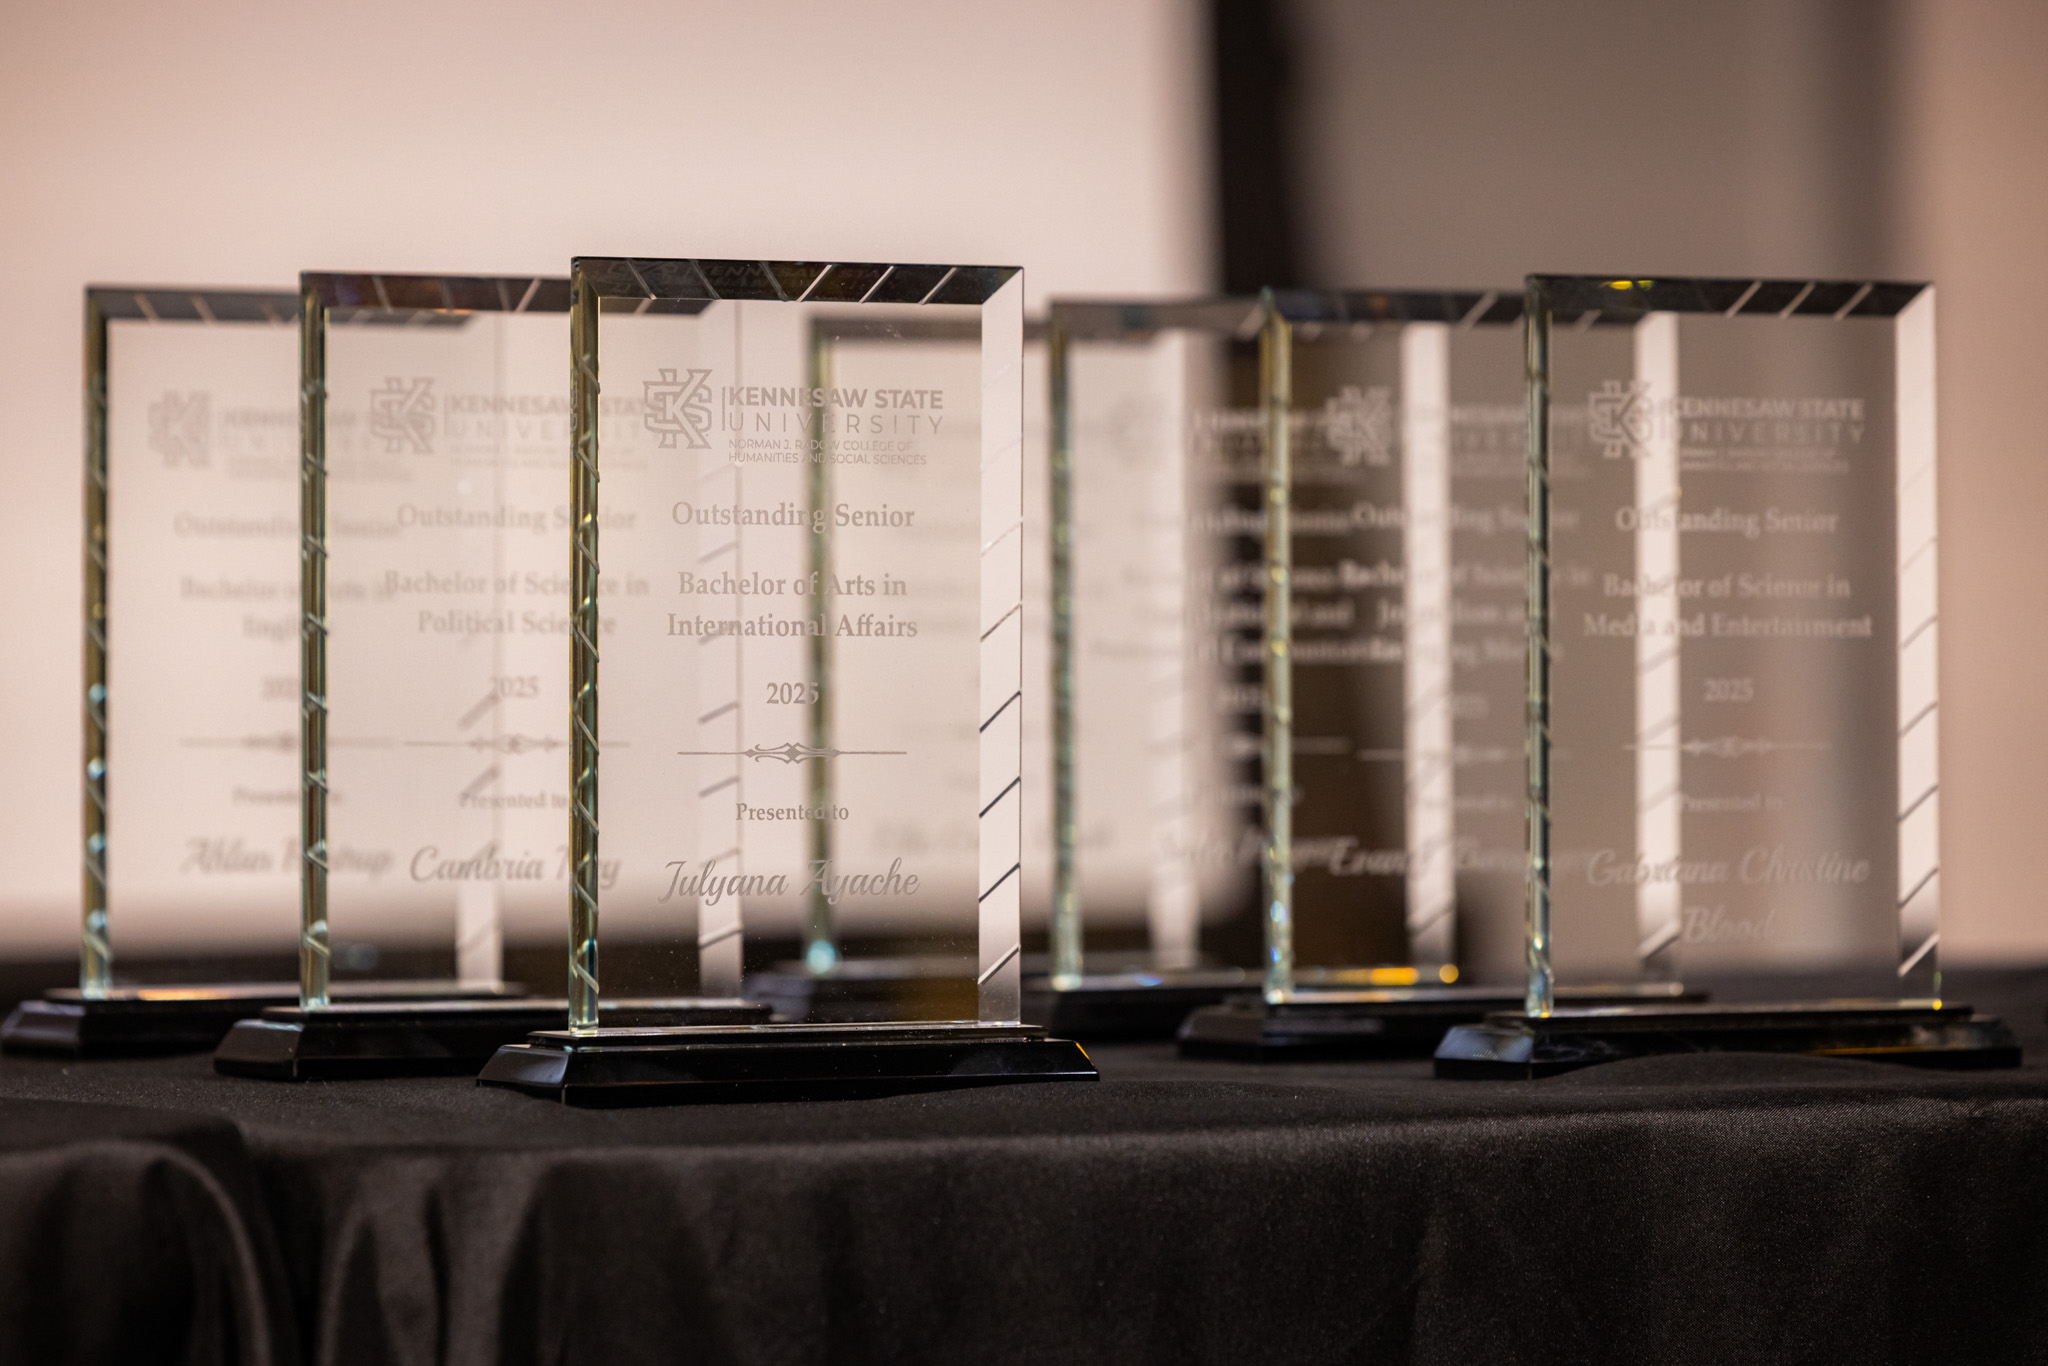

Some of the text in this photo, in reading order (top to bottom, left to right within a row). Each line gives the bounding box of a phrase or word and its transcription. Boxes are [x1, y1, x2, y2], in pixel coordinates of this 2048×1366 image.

[728, 386, 944, 410] KENNESAW STATE
[728, 412, 944, 434] UNIVERSITY
[728, 439, 913, 452] NORMAN J. RADOW COLLEGE OF
[728, 452, 927, 466] HUMANITIES AND SOCIAL SCIENCES
[397, 503, 548, 535] Outstanding
[553, 504, 637, 530] Sior
[671, 502, 915, 533] Outstanding Senior
[384, 569, 487, 594] Bachelor
[493, 570, 518, 595] of
[626, 571, 650, 597] in
[678, 571, 908, 596] Bachelor of Arts in
[1707, 572, 1733, 598] of
[1827, 573, 1852, 598] in
[417, 609, 515, 635] Political
[667, 613, 918, 638] International Affairs
[1710, 613, 1873, 638] Entertainment
[766, 682, 820, 705] 2025
[736, 803, 850, 821] Presented to
[409, 844, 545, 883] Cambria
[658, 858, 790, 906] Julyana
[800, 857, 920, 905] Ayache
